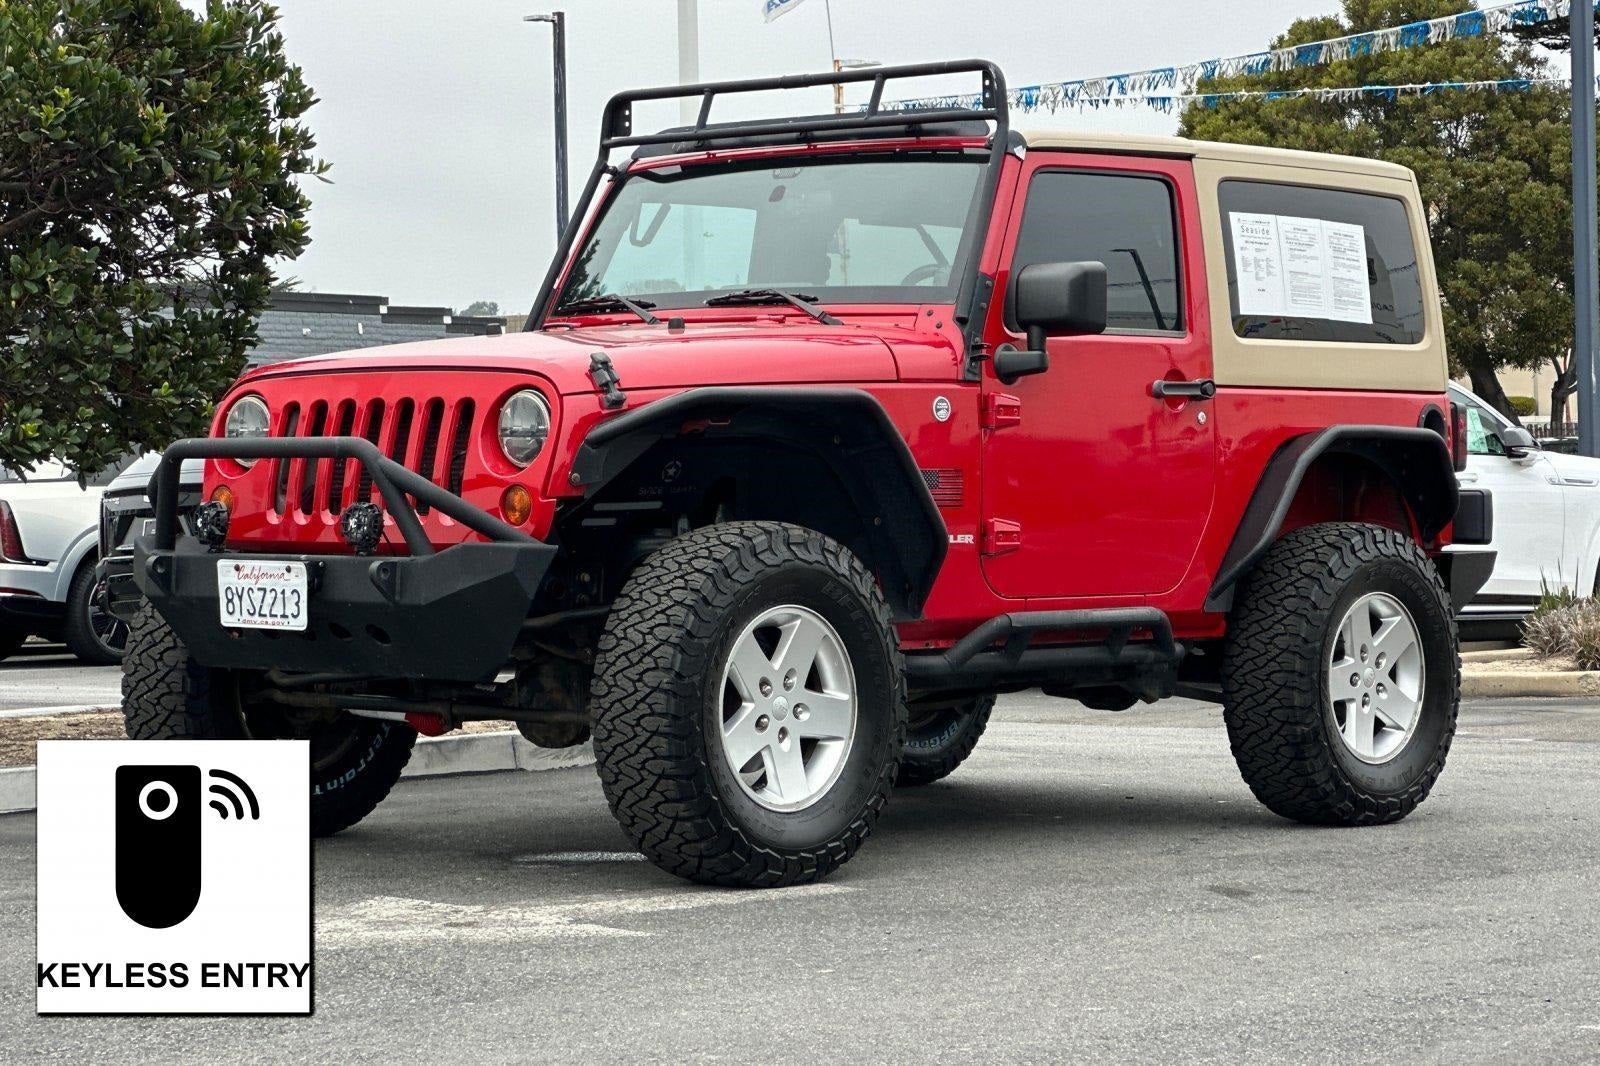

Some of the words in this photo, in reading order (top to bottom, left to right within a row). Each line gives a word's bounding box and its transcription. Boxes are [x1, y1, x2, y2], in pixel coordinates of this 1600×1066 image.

[1240, 225, 1270, 235] Seaside
[947, 534, 975, 544] LER
[237, 564, 287, 585] California
[225, 586, 301, 619] 8YSZ213
[242, 618, 285, 627] dmv.ca.gov
